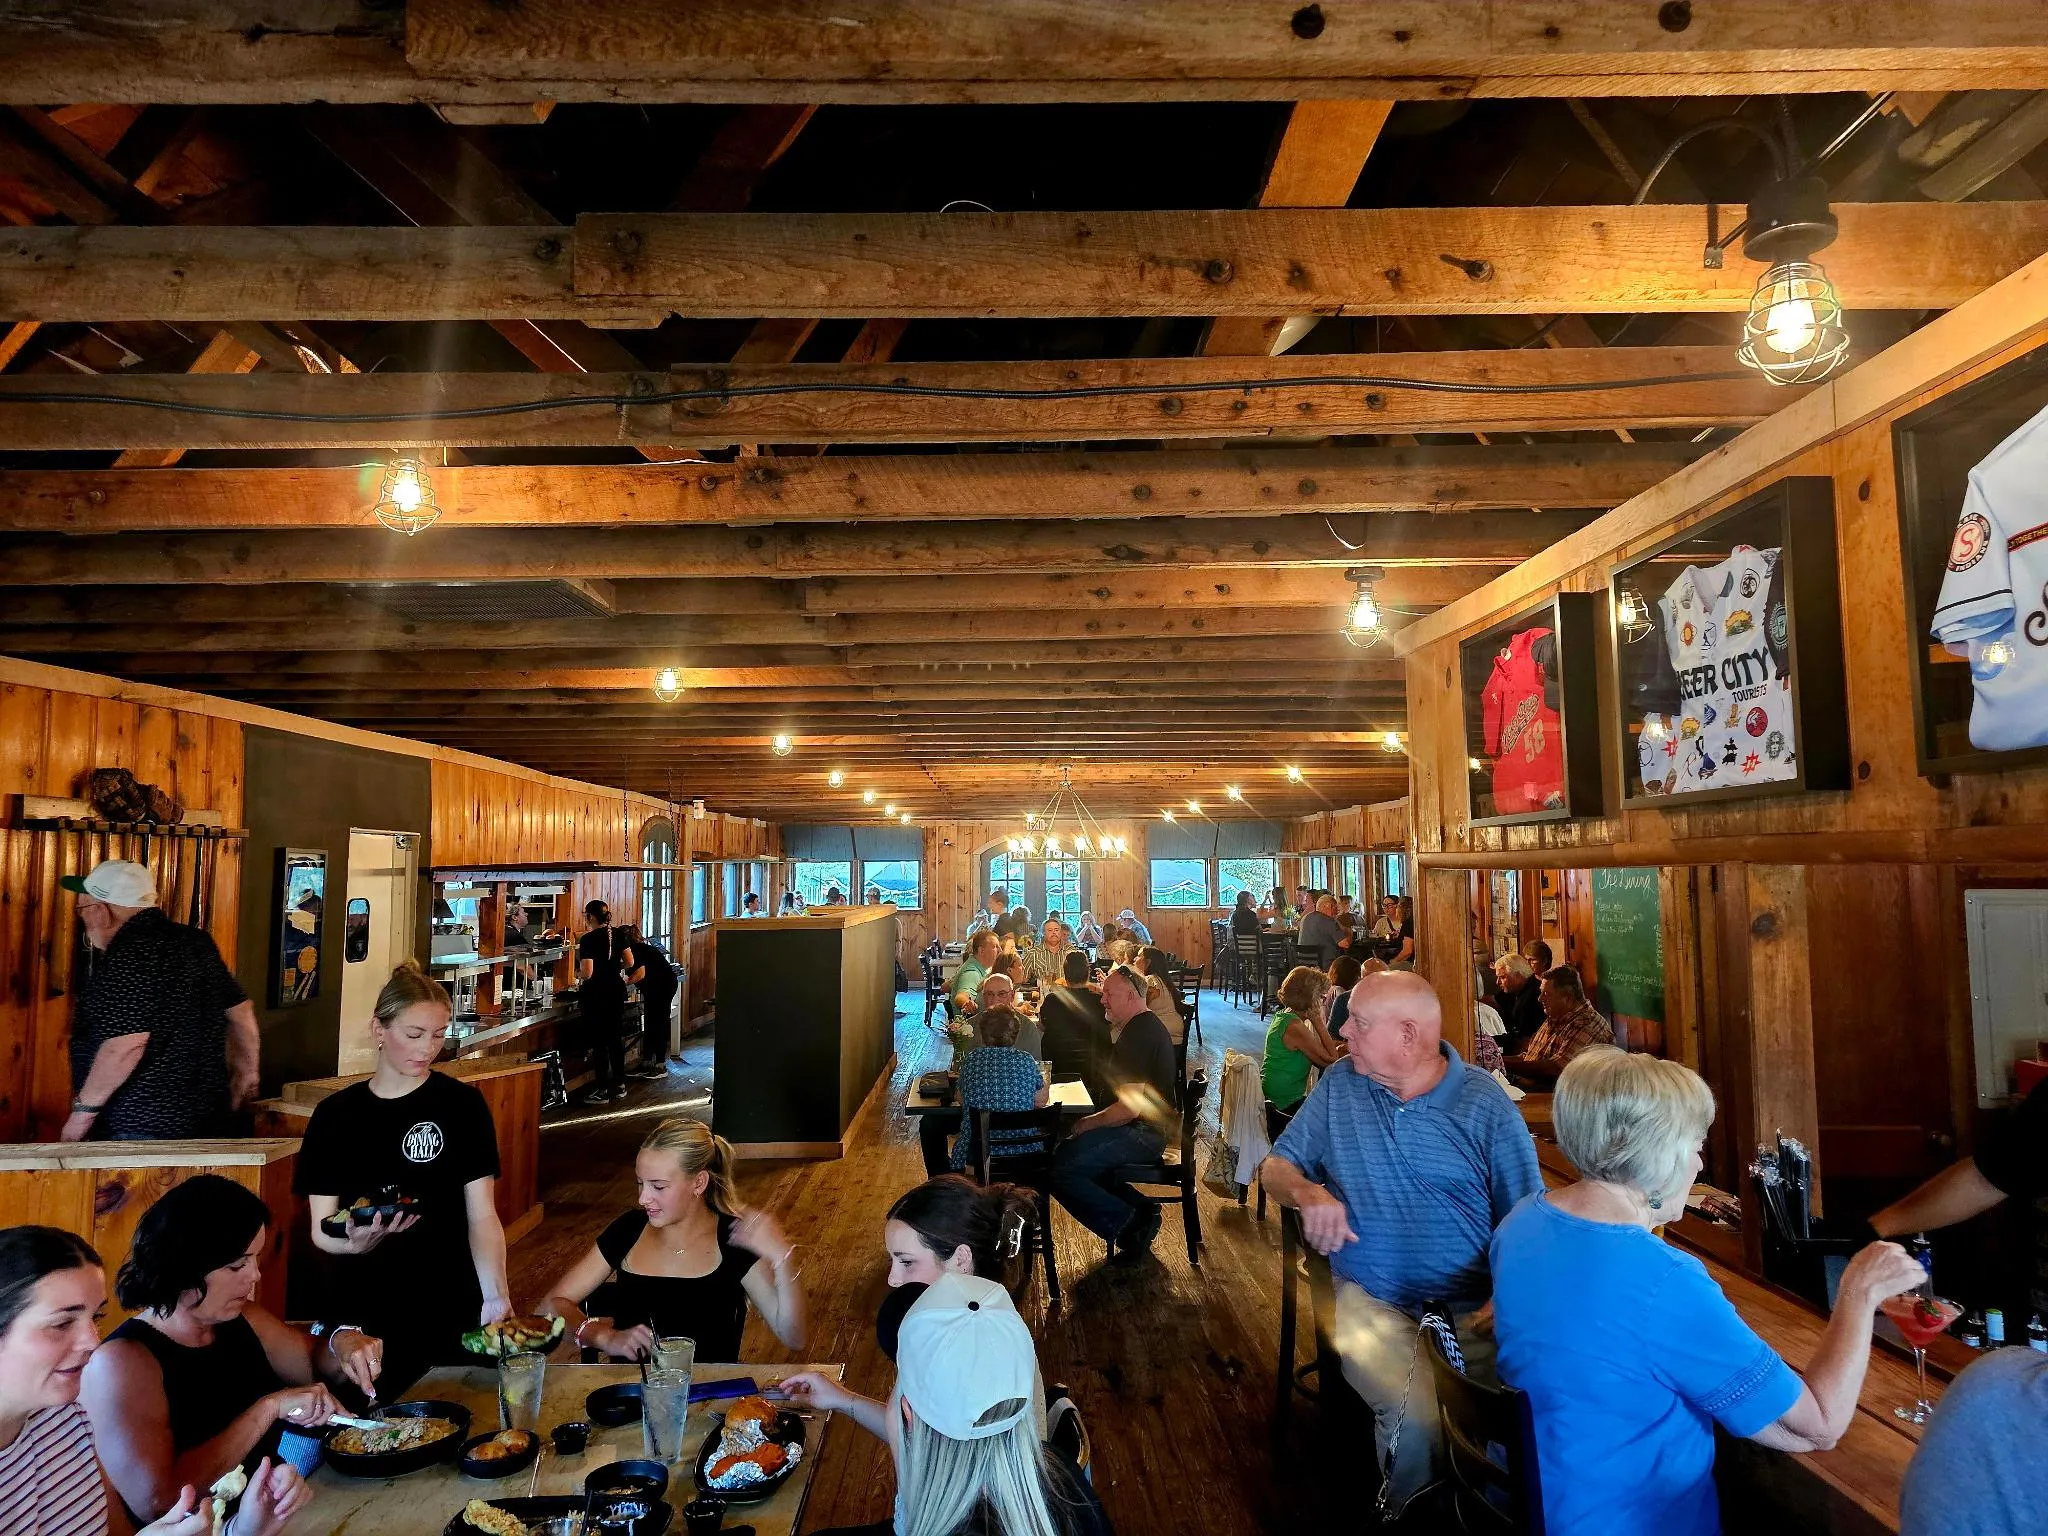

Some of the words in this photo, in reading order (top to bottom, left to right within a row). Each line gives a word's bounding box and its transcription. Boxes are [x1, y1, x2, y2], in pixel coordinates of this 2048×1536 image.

[1721, 646, 1769, 690] CITY
[406, 1134, 439, 1147] DINING
[410, 1145, 436, 1159] HALL
